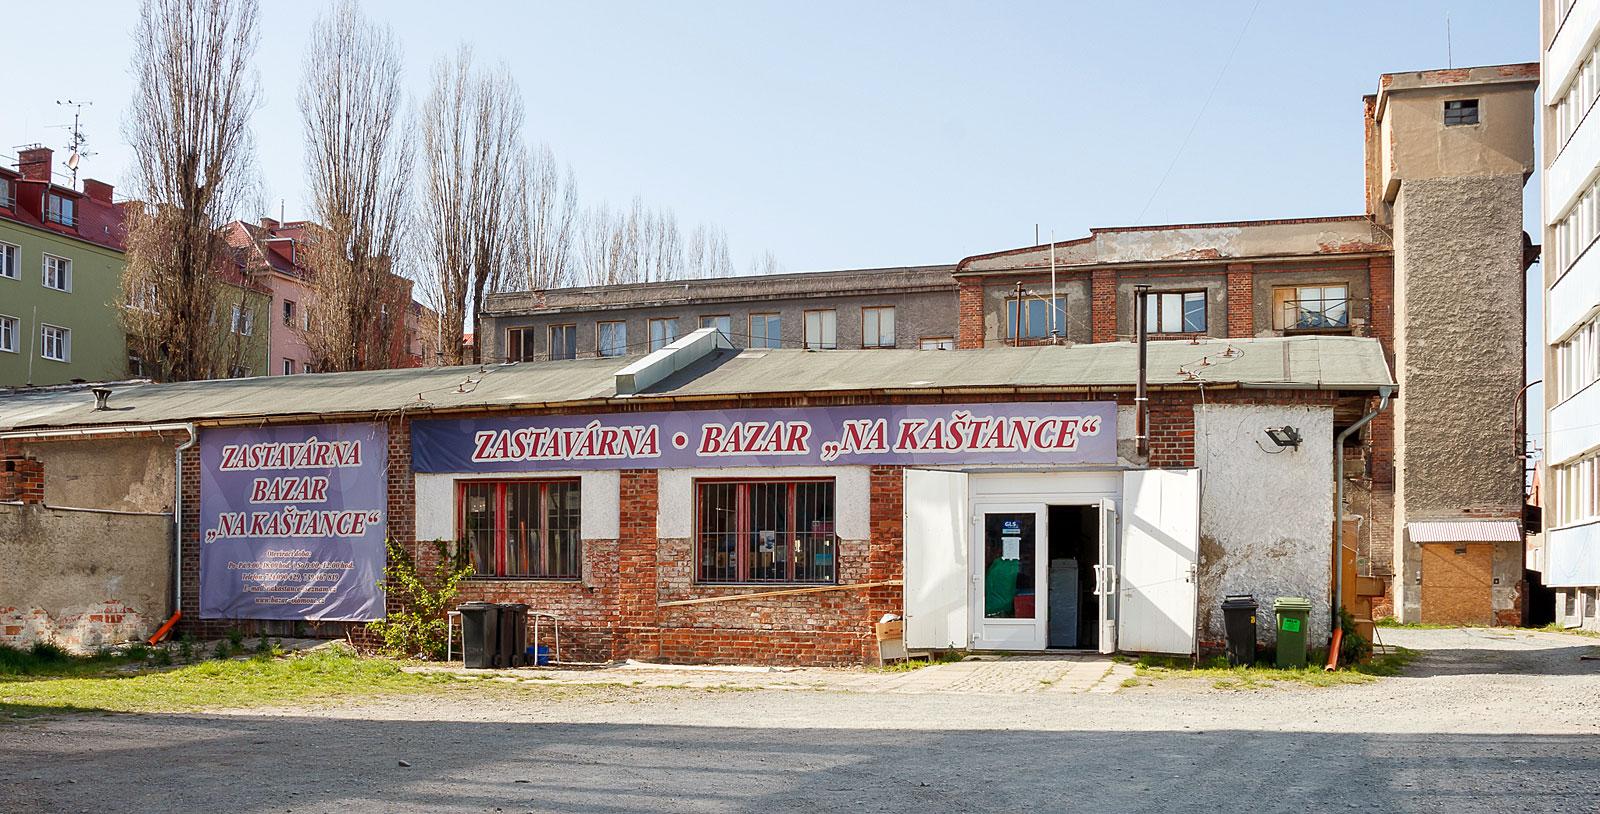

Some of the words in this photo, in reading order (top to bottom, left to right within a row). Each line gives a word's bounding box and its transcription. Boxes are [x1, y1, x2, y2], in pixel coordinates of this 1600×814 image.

[220, 436, 362, 471] ZASTAVÁRNA
[472, 420, 661, 463] ZASTAVÁRNA
[697, 421, 812, 457] BAZAR
[821, 417, 889, 461] „NA
[893, 410, 1102, 454] KAŠTANCE“
[250, 477, 328, 503] BAZAR
[205, 511, 247, 543] „NA
[249, 506, 381, 538] KAŠTANCE“
